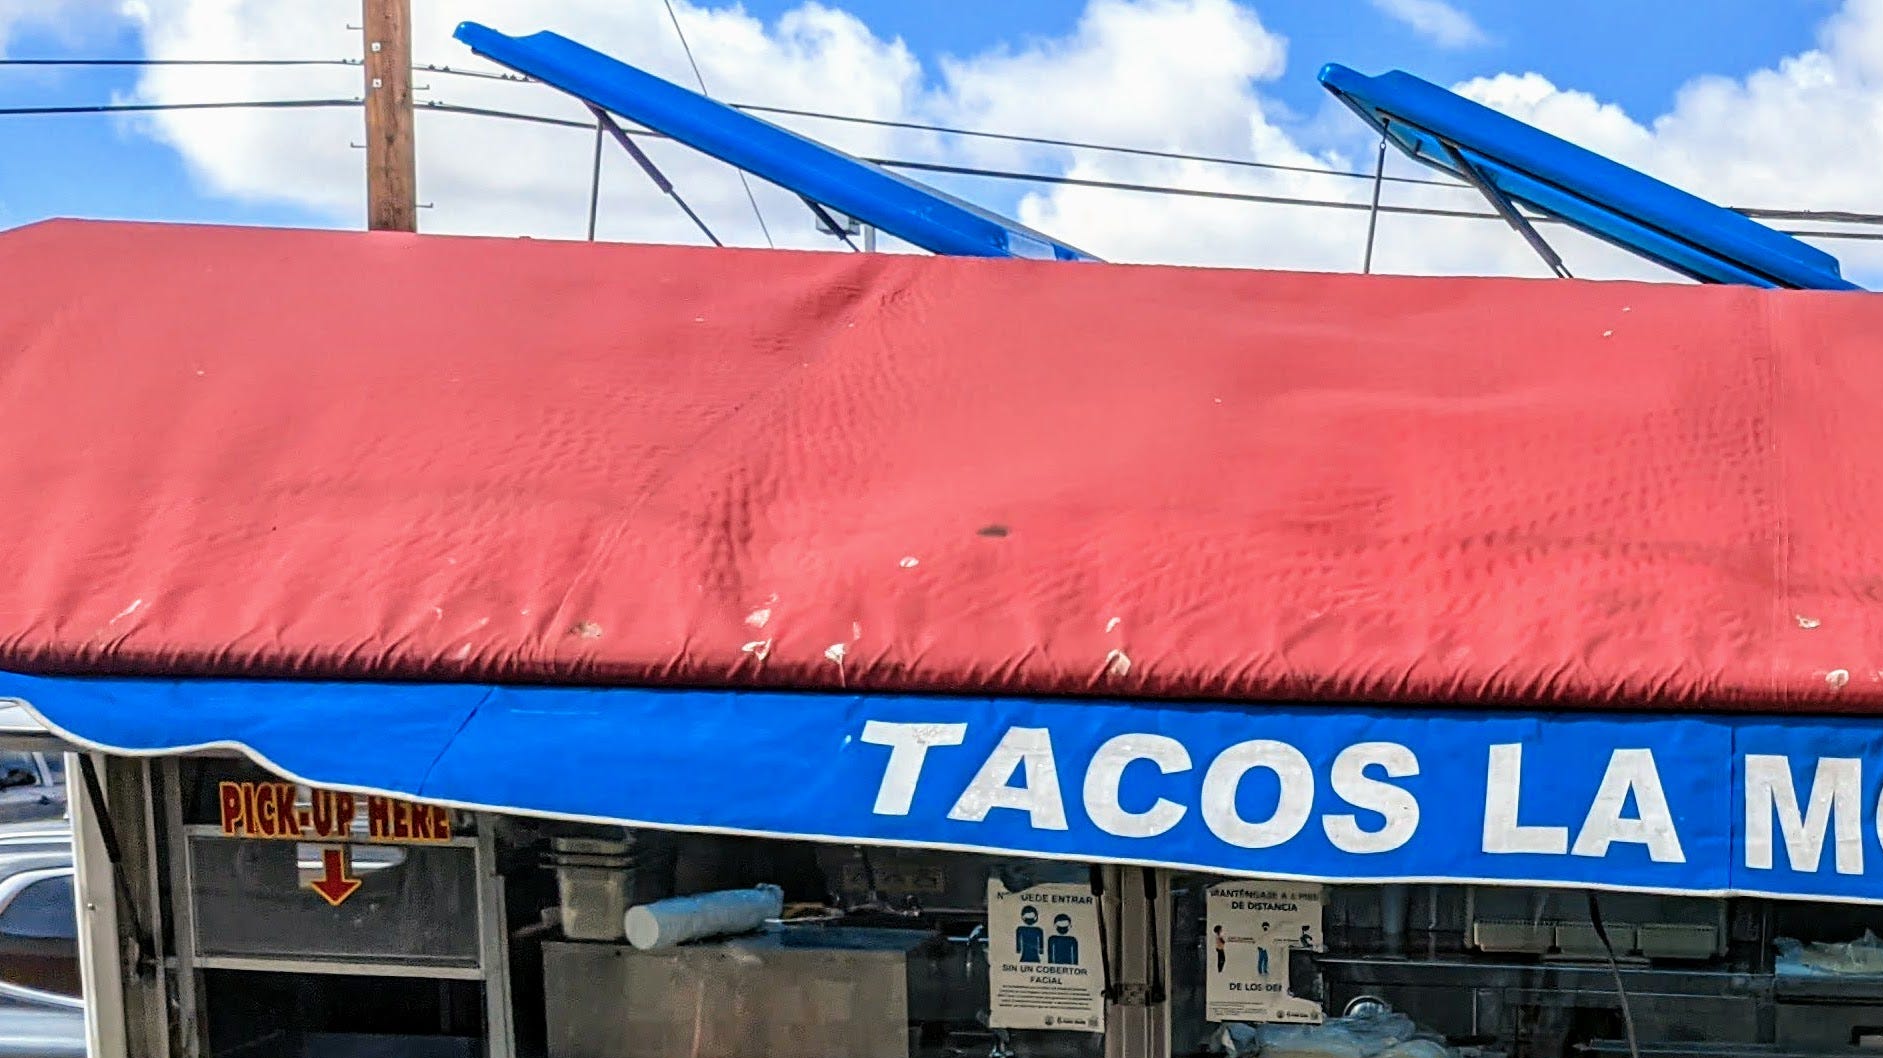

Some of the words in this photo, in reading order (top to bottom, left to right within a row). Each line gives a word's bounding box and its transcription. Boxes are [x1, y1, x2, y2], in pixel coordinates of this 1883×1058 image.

[860, 720, 1420, 855] TACOS
[1482, 743, 1687, 863] LA
[219, 781, 355, 838] PICK-UP
[368, 795, 453, 842] HERE
[1052, 895, 1093, 905] ENTRAR
[1231, 901, 1245, 910] DE
[1247, 902, 1298, 911] DISTANCIA
[1002, 964, 1017, 972] SIN
[1020, 965, 1033, 973] UN
[1036, 965, 1088, 976] COBERTOR
[1030, 976, 1062, 985] FACIAL
[1229, 982, 1242, 991] DE
[1245, 983, 1262, 991] LOS
